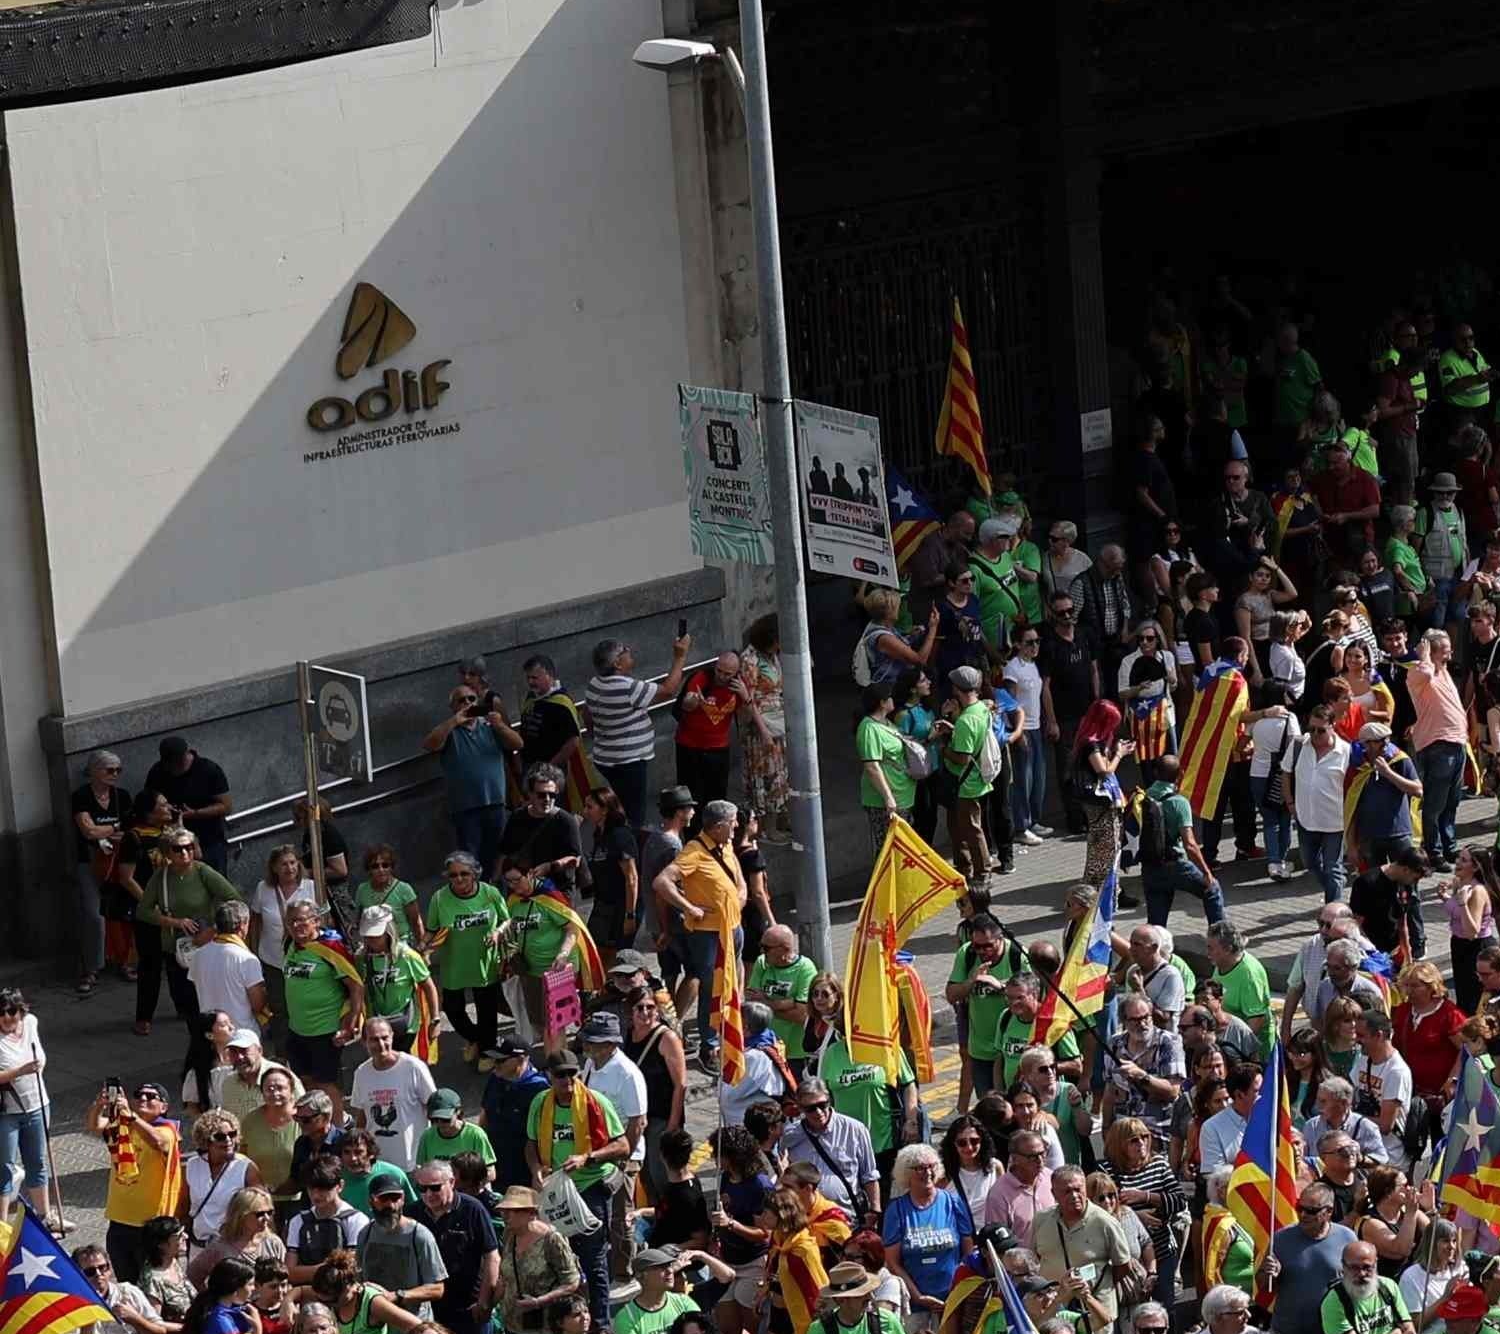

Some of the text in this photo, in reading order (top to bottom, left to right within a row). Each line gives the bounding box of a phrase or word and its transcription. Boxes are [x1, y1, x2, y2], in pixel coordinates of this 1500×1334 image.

[307, 359, 453, 432] adif
[304, 423, 460, 464] INFRAESTRUCTURAS FERROVIARIAS
[337, 422, 413, 445] ADMINISTRADOR
[706, 476, 751, 494] CONCERTS
